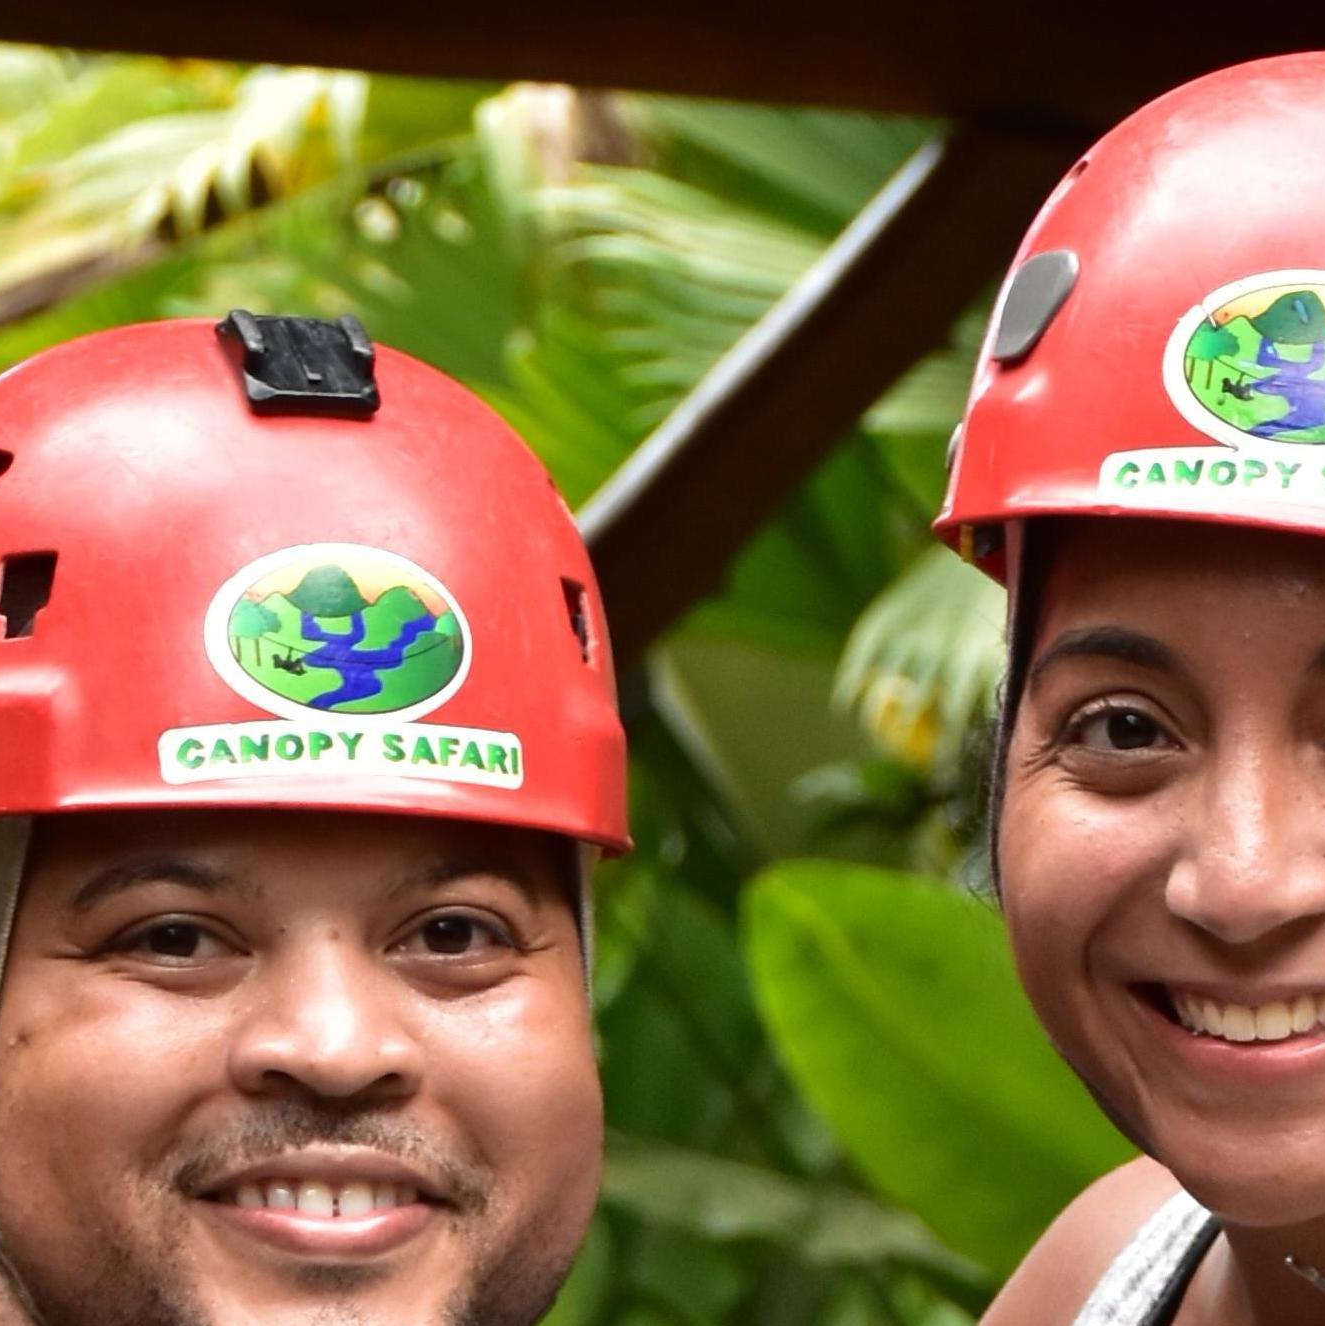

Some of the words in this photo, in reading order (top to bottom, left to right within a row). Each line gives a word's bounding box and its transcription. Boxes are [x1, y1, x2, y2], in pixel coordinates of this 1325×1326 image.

[1114, 459, 1302, 490] CANOPY
[175, 732, 364, 770] CANOPY
[382, 733, 520, 775] SAFARI
